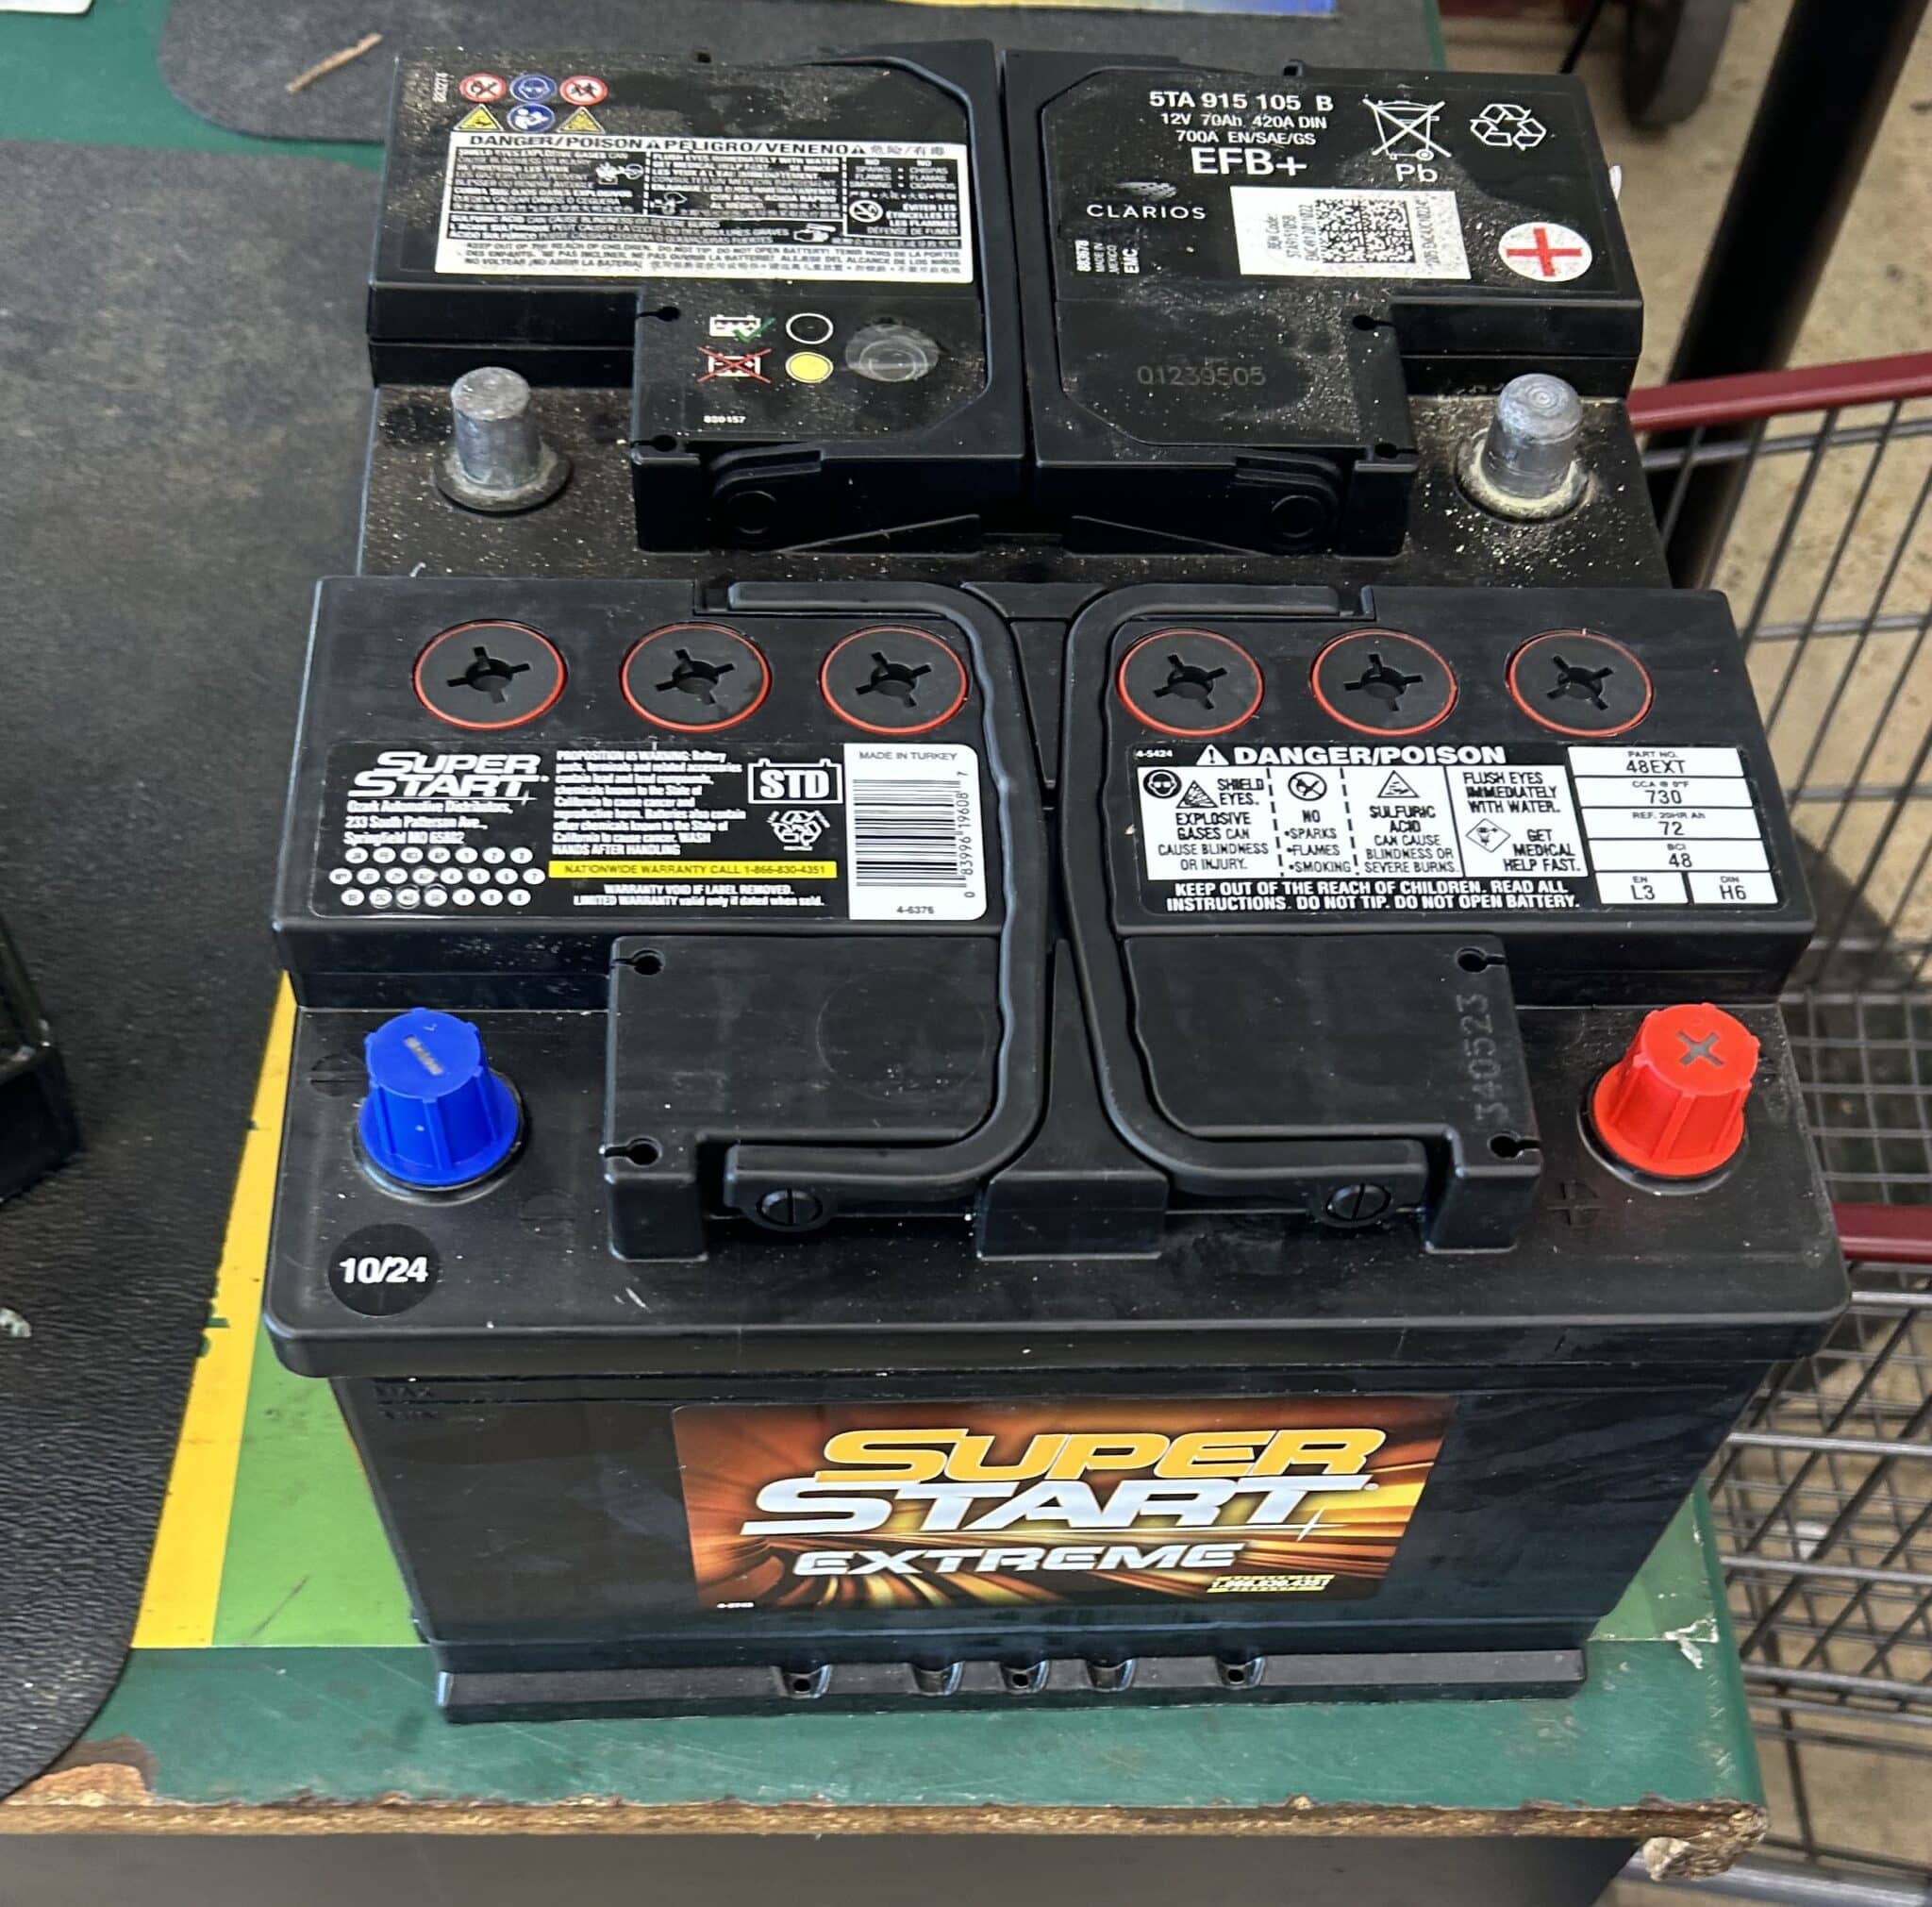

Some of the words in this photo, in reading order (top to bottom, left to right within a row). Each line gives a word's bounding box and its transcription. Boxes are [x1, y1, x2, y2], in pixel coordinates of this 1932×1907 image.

[1149, 91, 1195, 108] 5TA
[1201, 92, 1247, 109] 915
[1256, 94, 1301, 110] 105
[1316, 95, 1333, 111] B
[1161, 113, 1191, 125] 12V
[1202, 114, 1242, 127] 70Ah
[1253, 115, 1294, 128] 420A
[1299, 117, 1327, 128] DIN
[470, 135, 642, 150] DANGER/POISON
[1176, 130, 1219, 142] 700A
[1228, 131, 1316, 145] EN/SAE/GS
[664, 141, 848, 155] PELIGRO/VENENO
[1191, 146, 1308, 176] EFB+
[1395, 163, 1439, 183] Pb
[1087, 205, 1207, 220] CLARIOS
[1122, 248, 1140, 274] EMC
[374, 751, 541, 774] SUPER
[858, 752, 894, 761] MADE
[896, 752, 908, 761] IN
[910, 752, 958, 761] TURKEY
[1234, 746, 1507, 766] DANGER/POISON
[1626, 760, 1686, 774] 48EXT
[347, 770, 541, 797] START
[759, 769, 830, 799] STD
[1218, 778, 1264, 791] SHIELD
[1463, 771, 1505, 784] FLUSH
[1508, 771, 1542, 784] EYES
[1466, 785, 1557, 798] IMMEDIATELY
[1644, 790, 1683, 804] 730
[1220, 793, 1259, 806] EYES.
[1470, 800, 1504, 813] WITH
[1509, 800, 1561, 813] WATER.
[956, 792, 971, 828] 19608
[1303, 810, 1321, 823] NO
[1369, 806, 1436, 818] SULFURIC
[1175, 812, 1251, 826] EXPLOSIVE
[1390, 820, 1422, 832] ACID
[1177, 828, 1221, 840] GASES
[1226, 828, 1250, 840] CAN
[1526, 828, 1552, 842] GET
[1658, 821, 1685, 836] 72
[1374, 835, 1397, 846] CAN
[1402, 835, 1441, 846] CAUSE
[958, 836, 974, 876] 83996
[1158, 844, 1197, 856] CAUSE
[1201, 843, 1269, 855] BLINDNESS
[1366, 848, 1433, 861] BLINDNESS
[1437, 848, 1455, 860] OR
[1512, 844, 1575, 857] MEDICAL
[1180, 859, 1198, 871] OR
[1201, 858, 1248, 871] INJURY.
[1365, 861, 1409, 873] SEVERE
[1413, 861, 1460, 873] BURNS.
[1504, 859, 1538, 871] HELP
[1542, 859, 1581, 871] FAST.
[1669, 853, 1692, 868] 48
[565, 865, 638, 874] NATIONWIDE
[641, 865, 706, 874] WARRANTY
[710, 865, 740, 874] CALL
[1174, 882, 1215, 896] KEEP
[1220, 881, 1254, 895] OUT
[1257, 881, 1277, 895] OF
[1281, 881, 1314, 895] THE
[1317, 880, 1371, 895] REACH
[1375, 880, 1396, 895] OF
[1400, 880, 1487, 895] CHILDREN.
[1491, 880, 1534, 894] READ
[1538, 880, 1569, 894] ALL
[1631, 885, 1656, 900] L3
[1720, 885, 1747, 900] H6
[1166, 895, 1291, 912] INSTRUCTIONS.
[1296, 895, 1321, 911] DO
[1324, 895, 1358, 911] NOT
[1362, 895, 1391, 910] TIP.
[1394, 895, 1418, 910] DO
[1422, 895, 1455, 910] NOT
[1458, 895, 1502, 910] OPEN
[1506, 895, 1581, 909] BATTERY.
[339, 1256, 429, 1283] 10/24
[814, 1428, 1387, 1482] SUPER
[741, 1475, 1374, 1535] START
[793, 1544, 1245, 1577] EXTREME
